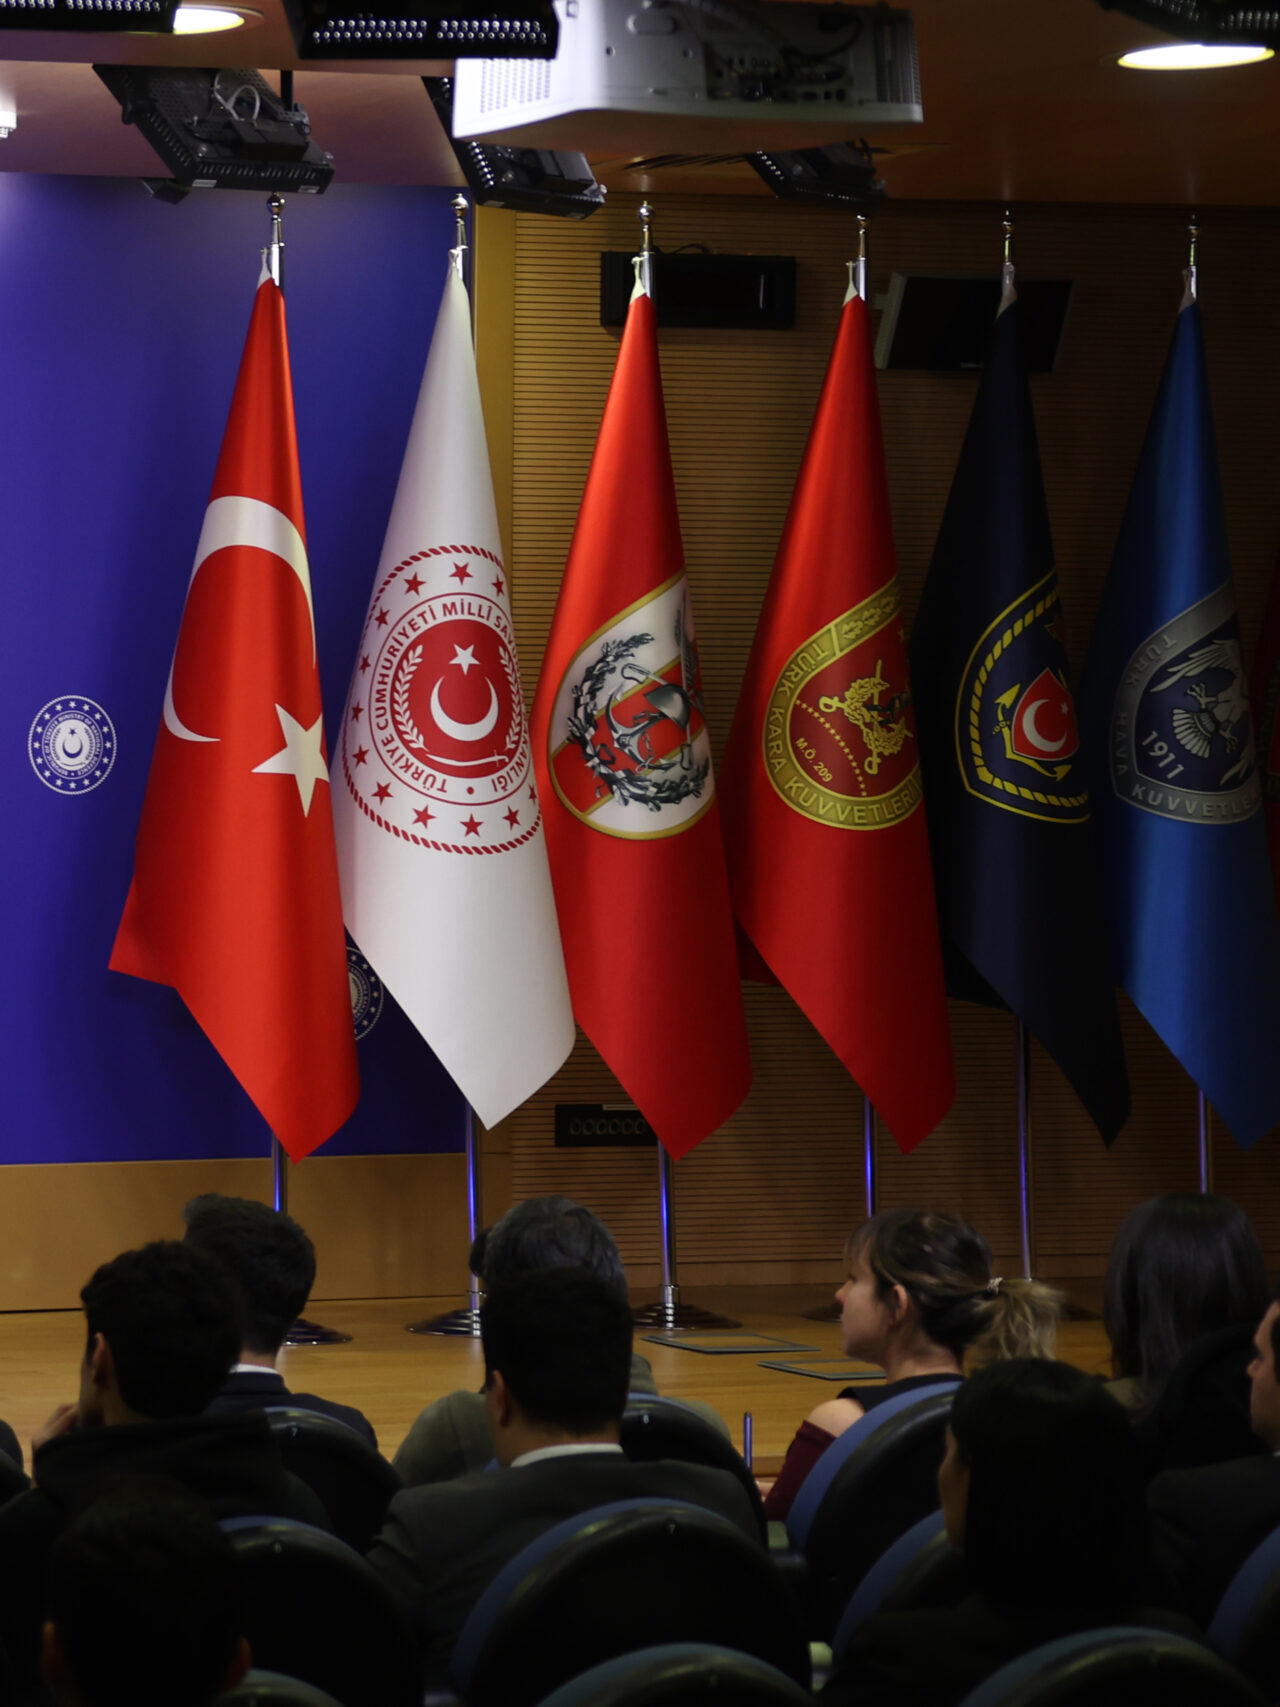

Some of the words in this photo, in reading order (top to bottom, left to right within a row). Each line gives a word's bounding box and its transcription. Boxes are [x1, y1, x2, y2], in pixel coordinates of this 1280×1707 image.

[442, 598, 494, 621] MİLLÎ
[375, 603, 437, 731] CUMHURİYETİ
[776, 643, 828, 697] TÜRK
[381, 732, 448, 795] TÜRKİYE
[767, 707, 787, 773] KARA
[795, 738, 816, 762] M.Ö.
[813, 761, 833, 783] 209
[1142, 730, 1185, 779] 1911
